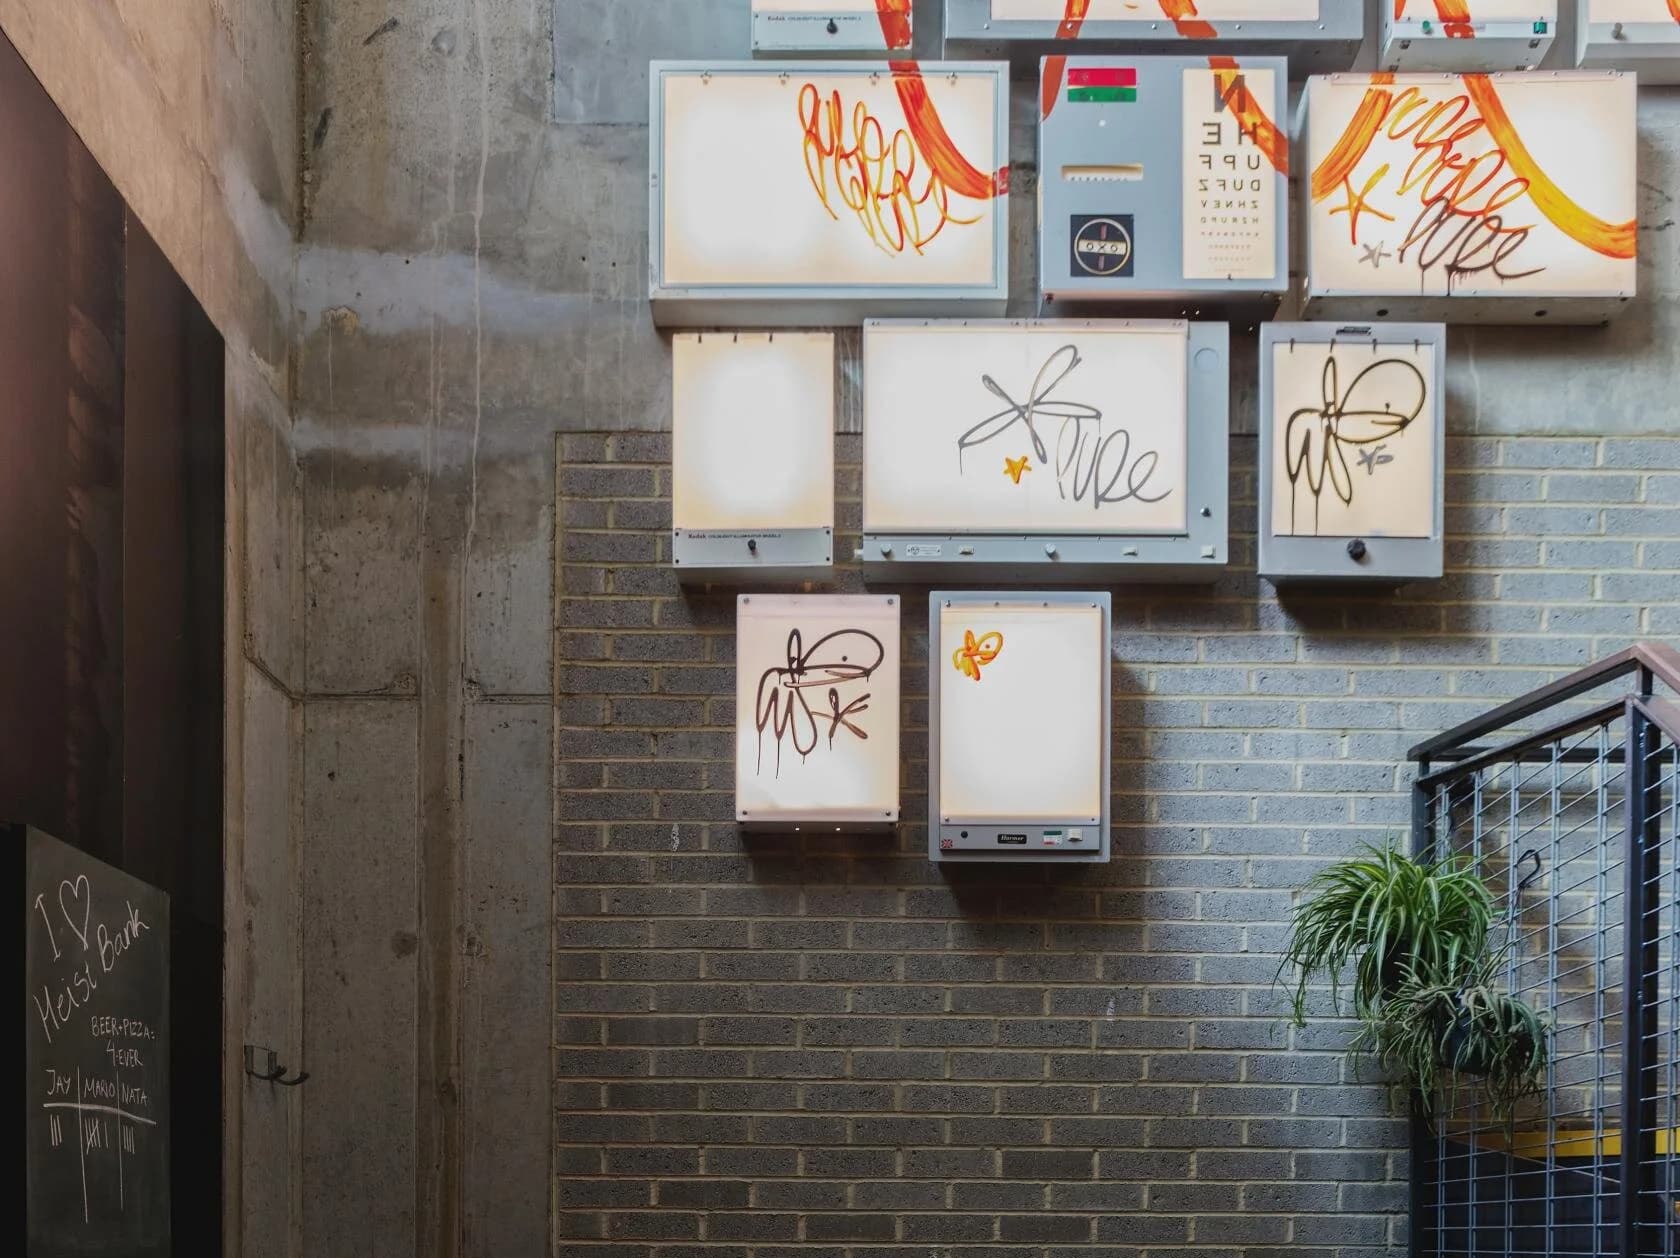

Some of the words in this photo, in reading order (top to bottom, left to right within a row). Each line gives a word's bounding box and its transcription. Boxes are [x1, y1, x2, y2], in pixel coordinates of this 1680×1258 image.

[34, 893, 61, 963] I
[96, 900, 150, 973] Bank
[45, 1069, 71, 1096] JAY
[84, 1077, 115, 1100] MARIO
[121, 1082, 148, 1107] NATA
